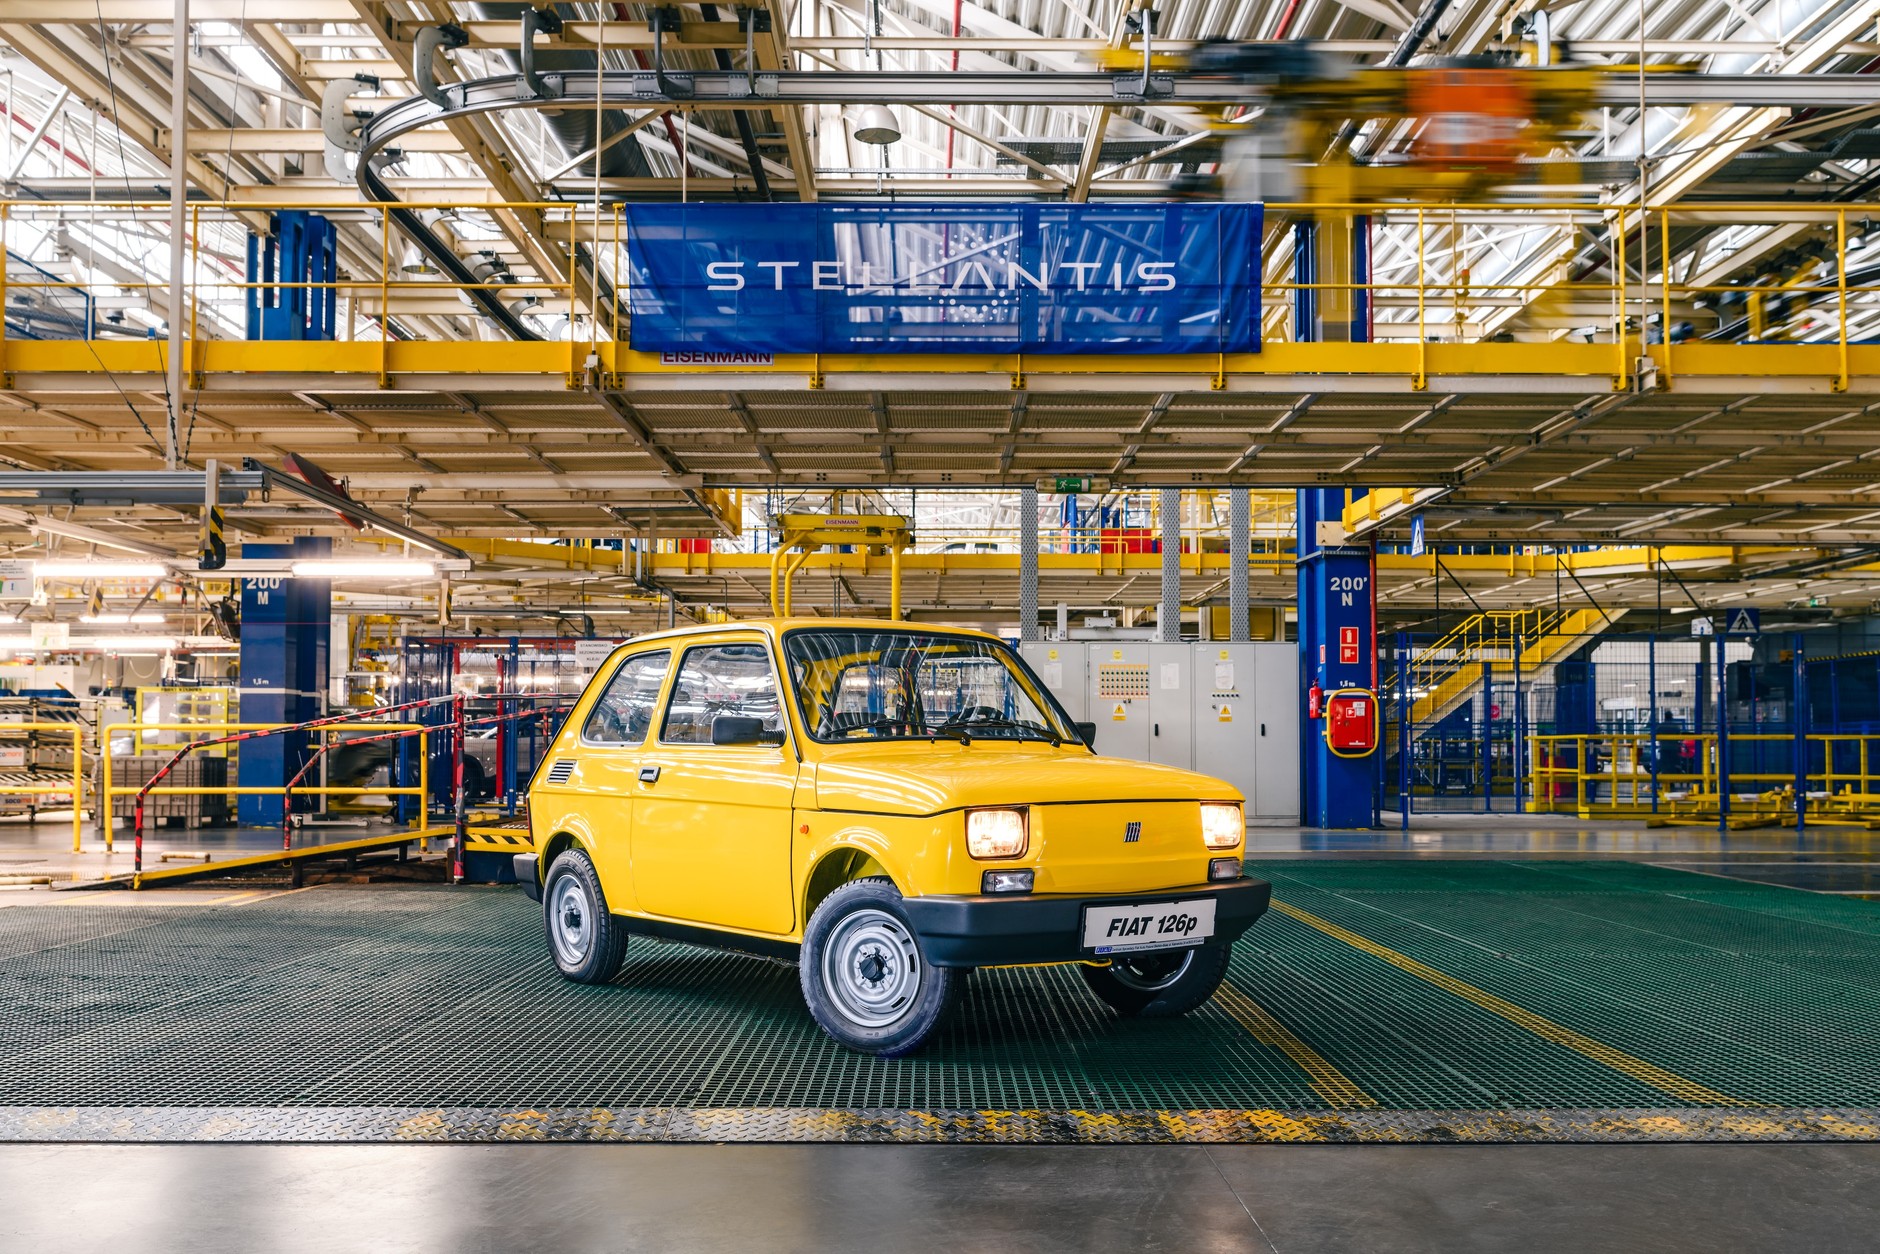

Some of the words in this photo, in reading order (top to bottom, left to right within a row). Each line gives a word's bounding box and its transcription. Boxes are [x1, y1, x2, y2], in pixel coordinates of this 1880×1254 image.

[707, 261, 1177, 292] STELLANTIS
[663, 352, 771, 363] EISENMANN
[1330, 576, 1368, 591] 200'
[257, 591, 269, 605] M
[1341, 592, 1353, 606] N
[1339, 680, 1349, 688] 1,5
[1106, 916, 1154, 938] FIAT
[1157, 913, 1198, 937] 126p
